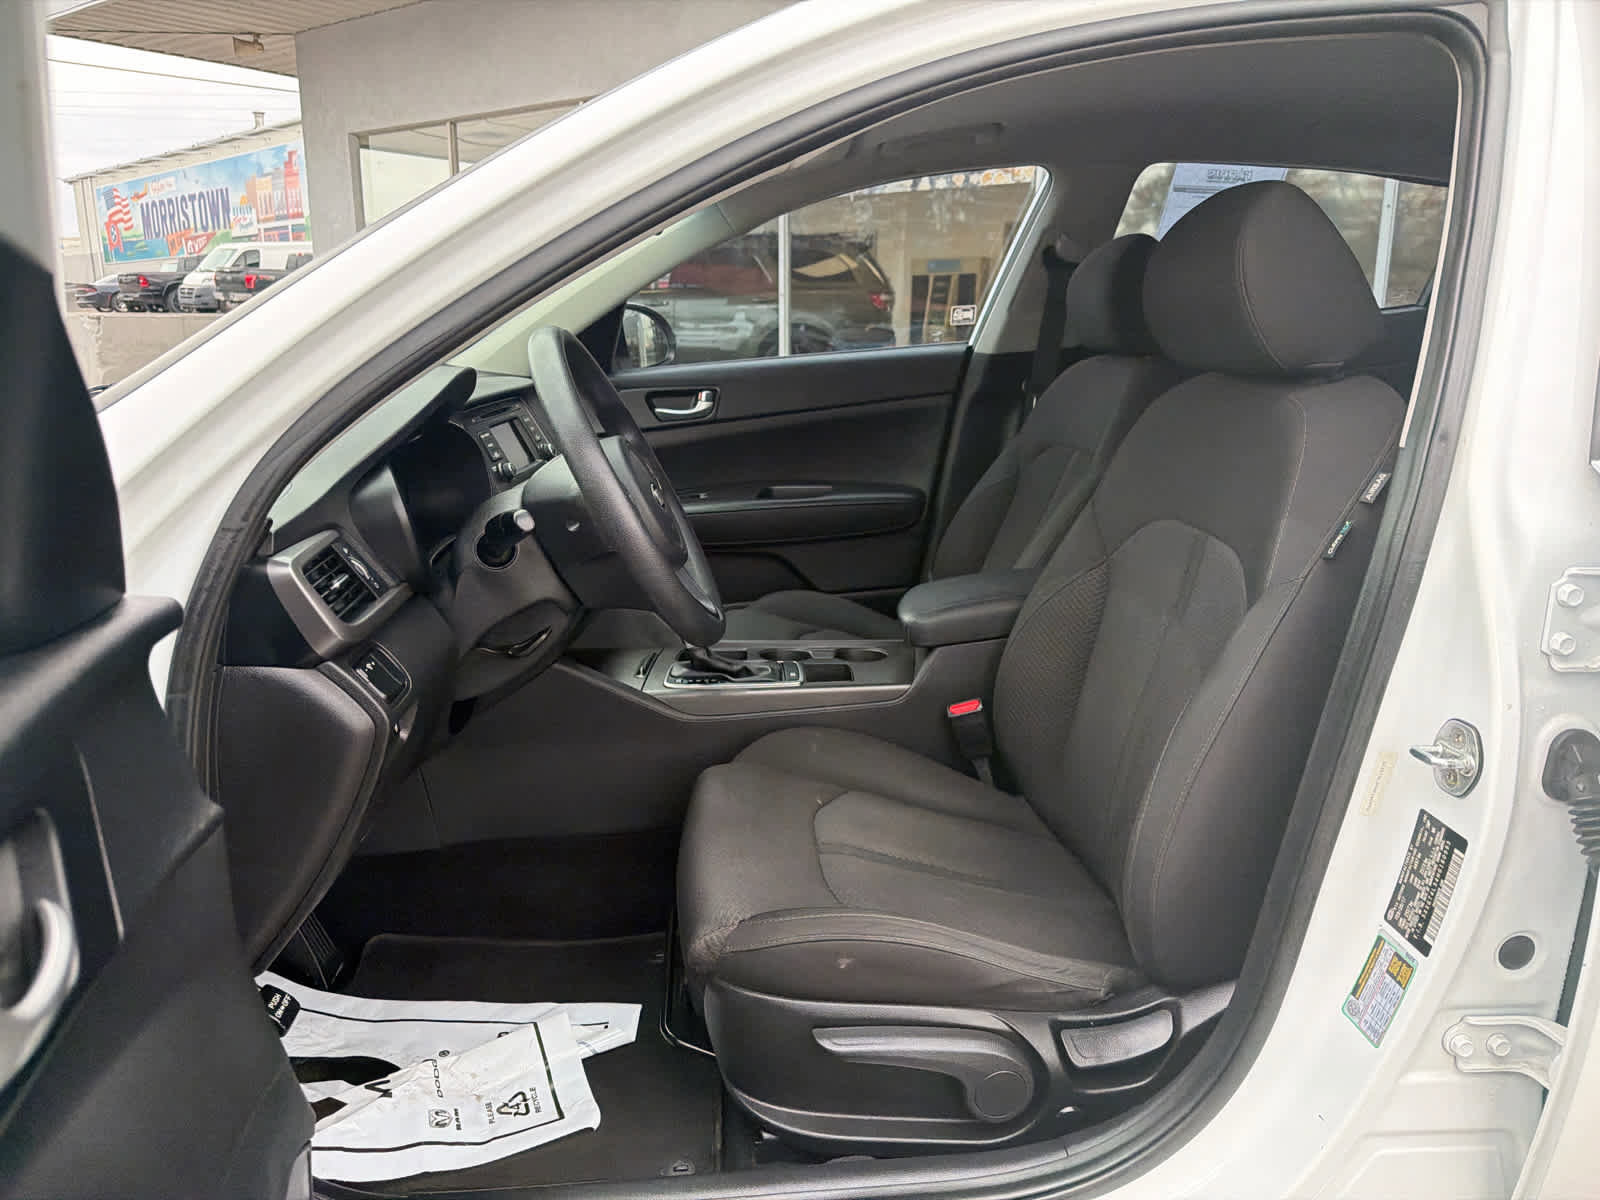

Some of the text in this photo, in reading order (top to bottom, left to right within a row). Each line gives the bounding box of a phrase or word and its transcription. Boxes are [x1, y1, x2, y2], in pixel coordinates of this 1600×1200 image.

[140, 187, 231, 240] MORRISTOWN
[267, 993, 281, 1010] PUSH
[432, 1058, 444, 1098] DODG
[529, 1087, 541, 1113] RECYCLE
[454, 1108, 462, 1131] RAM
[485, 1102, 495, 1125] PLEASE
